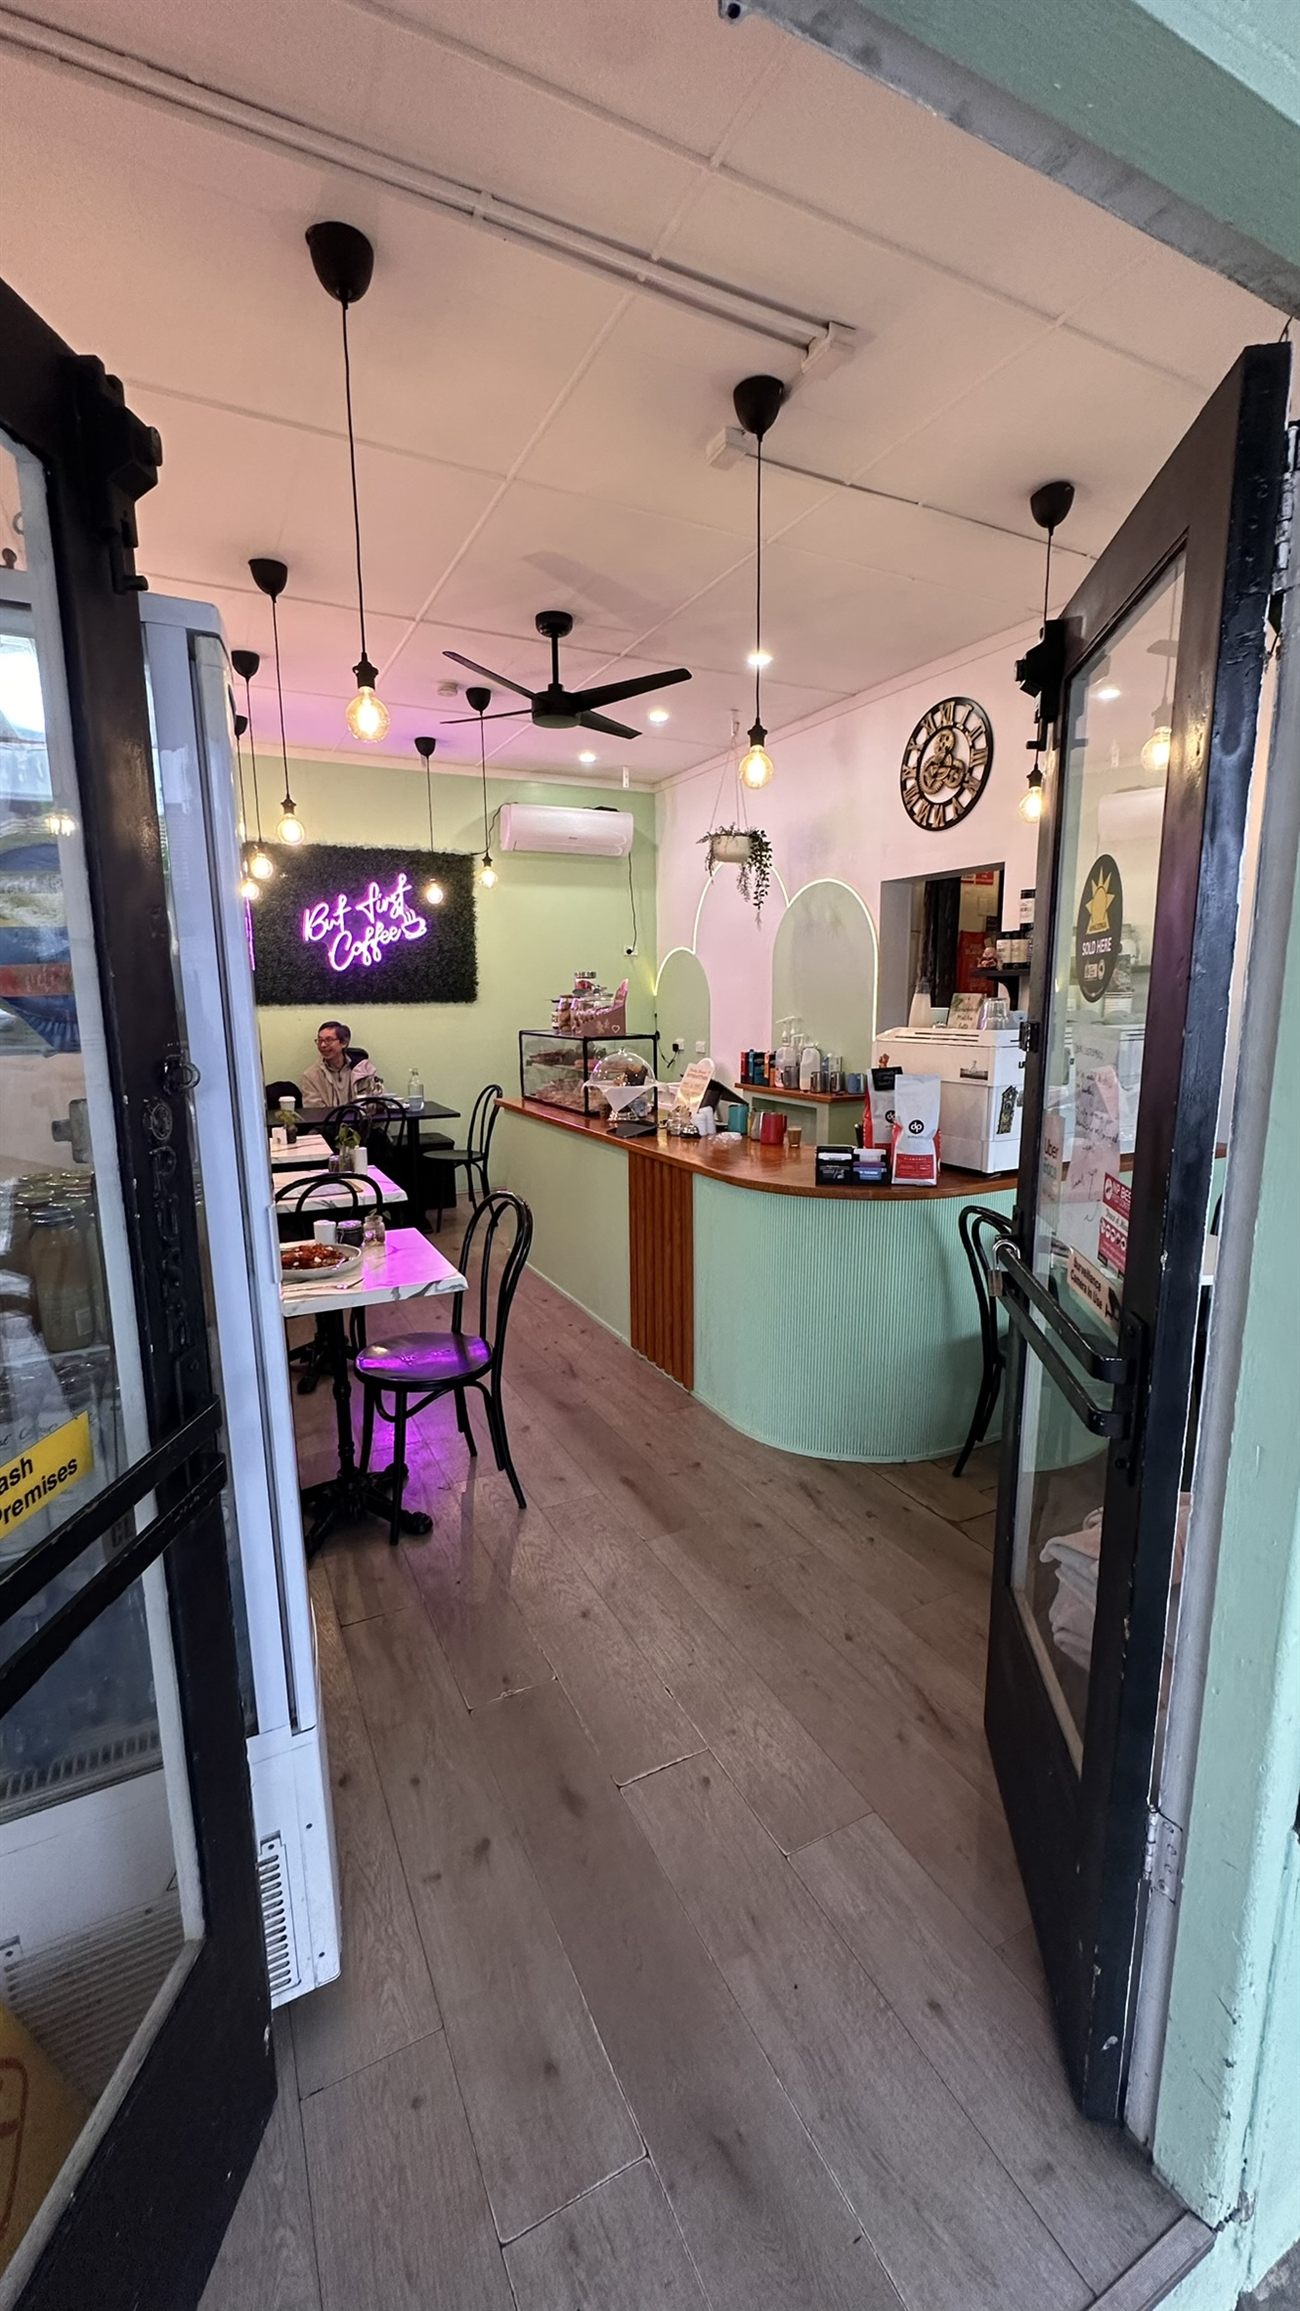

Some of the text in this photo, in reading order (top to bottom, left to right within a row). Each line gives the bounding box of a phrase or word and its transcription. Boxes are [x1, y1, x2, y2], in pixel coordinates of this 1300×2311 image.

[304, 893, 352, 942] But
[328, 921, 402, 972] Coffee
[1081, 937, 1112, 956] SOLD HERE
[1044, 1138, 1059, 1159] Uber
[1070, 1269, 1087, 1294] Camera
[1093, 1291, 1103, 1309] Use
[1073, 1256, 1101, 1292] Surveillance
